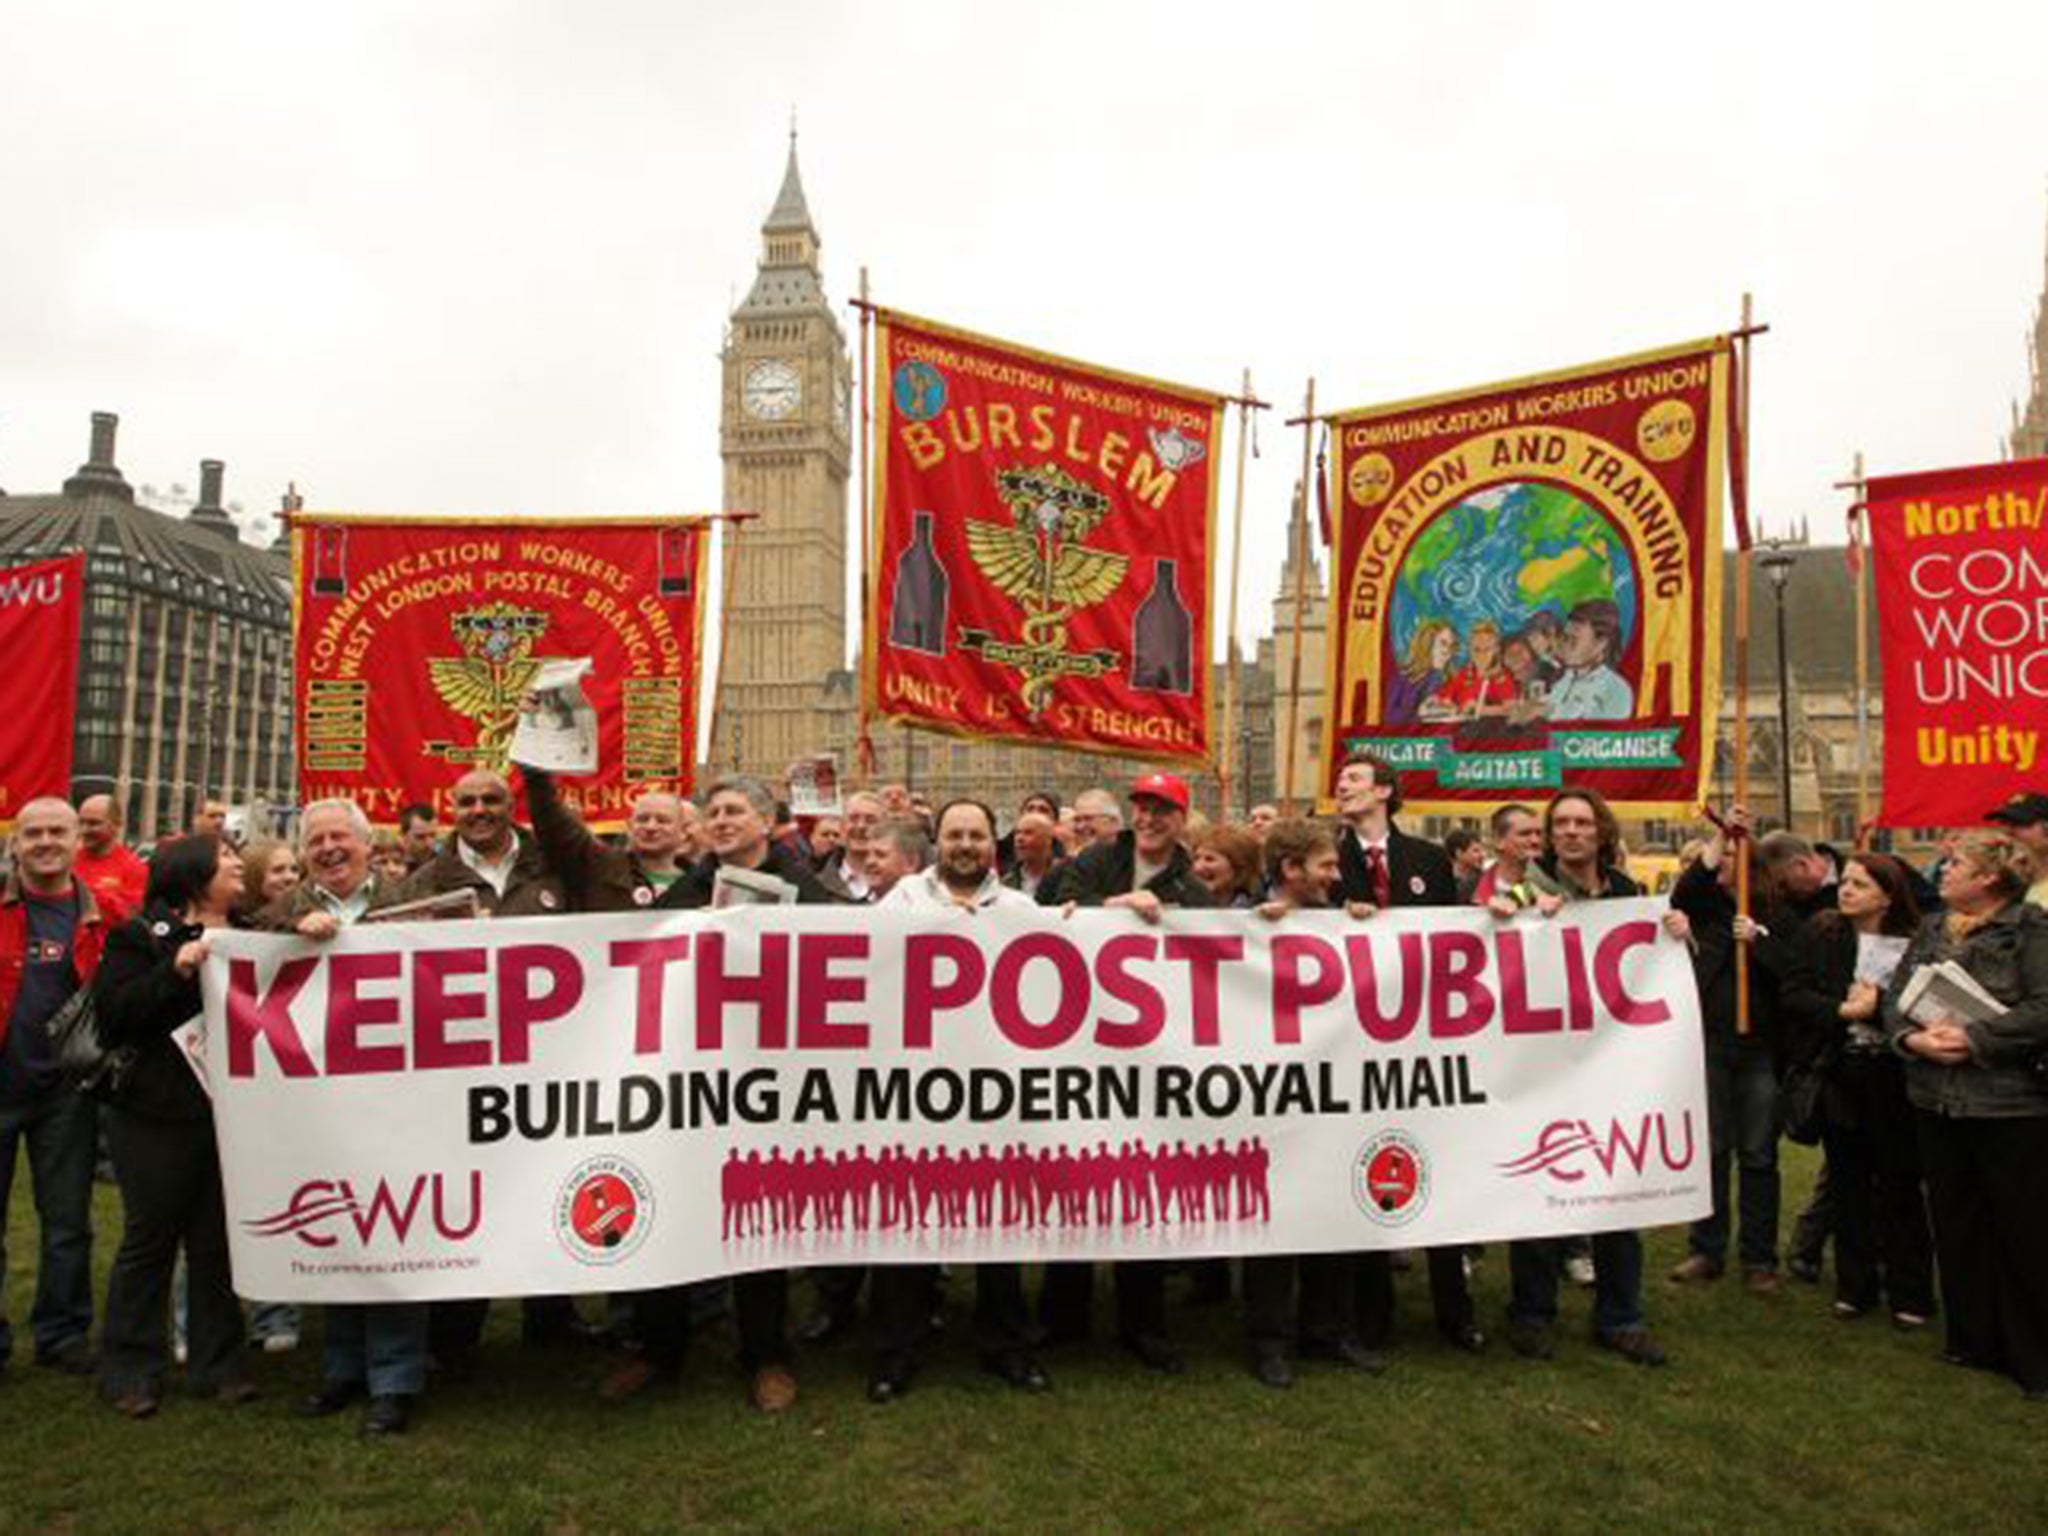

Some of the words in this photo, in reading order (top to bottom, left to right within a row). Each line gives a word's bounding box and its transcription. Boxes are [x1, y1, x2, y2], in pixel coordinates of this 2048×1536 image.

[896, 337, 1053, 395] COMMUNICATION
[1062, 381, 1142, 417] WORKERS
[1150, 403, 1207, 433] UNION
[1346, 406, 1510, 448] COMMUNICATION
[1516, 382, 1616, 415] WORKERS
[1624, 363, 1708, 399] UNION
[901, 404, 1177, 510] BURSLEM
[1355, 454, 1468, 621] EDUCATION
[1491, 435, 1566, 467] AND
[1578, 445, 1684, 600] TRAINING
[310, 541, 500, 672] COMMUNICATION
[520, 542, 634, 593] WORKERS
[638, 594, 681, 675] UNION
[337, 618, 376, 678] WEST
[375, 571, 473, 619] LONDON
[485, 571, 571, 599] POSTAL
[583, 588, 652, 676] BRANCH
[886, 673, 960, 713] UNITY
[986, 695, 1009, 719] IS
[1058, 703, 1196, 744] STRENGTH
[1563, 735, 1671, 760] ORGANISE
[1916, 724, 2039, 771] Unity
[1455, 758, 1543, 781] AGITATE
[226, 943, 584, 1077] KEEP
[609, 932, 872, 1055] THE
[904, 932, 1244, 1050] POST
[1271, 921, 1671, 1045] PUBLIC
[468, 1067, 781, 1144] BUILDING
[793, 1067, 839, 1122] A
[853, 1066, 1141, 1122] MODERN
[1155, 1061, 1350, 1118] ROYAL
[1361, 1054, 1487, 1111] MAIL
[1539, 1110, 1694, 1182] CWU
[288, 1169, 481, 1247] CWU
